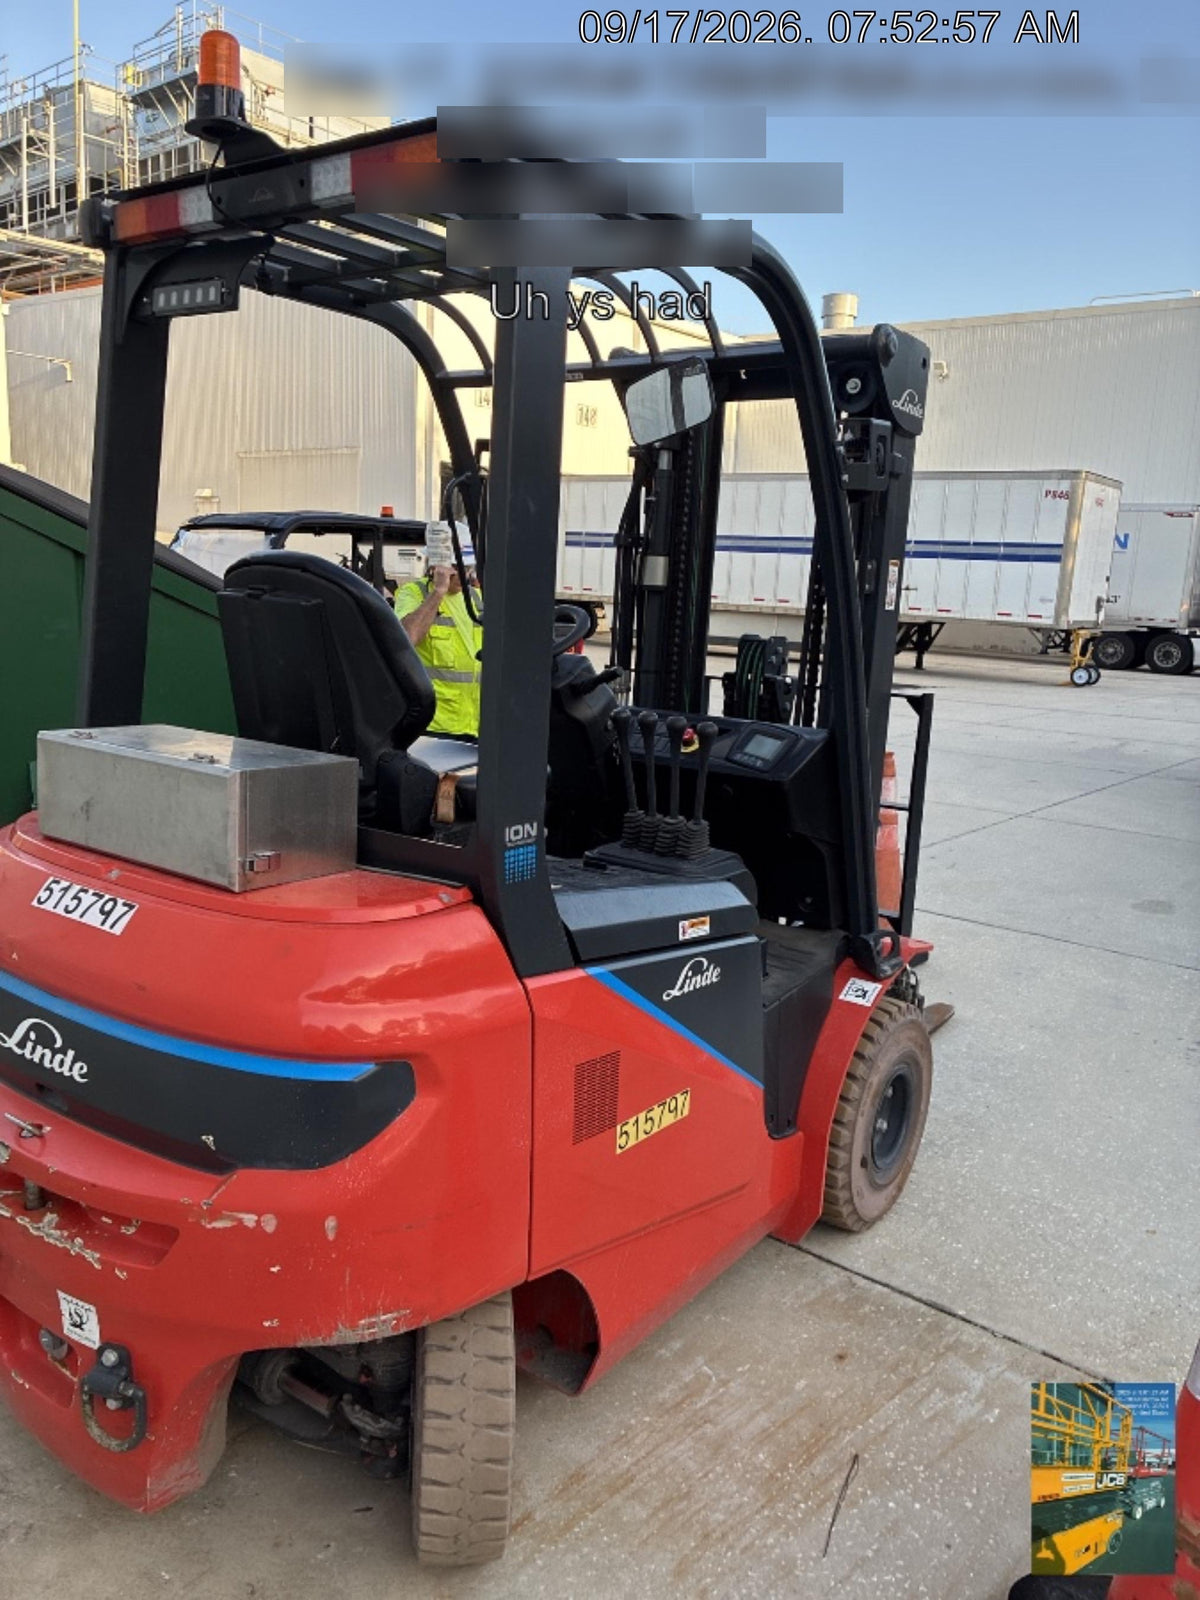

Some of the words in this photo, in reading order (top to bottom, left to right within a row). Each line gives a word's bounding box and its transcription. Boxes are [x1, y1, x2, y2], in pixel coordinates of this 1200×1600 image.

[504, 822, 538, 842] ION
[35, 879, 136, 930] 515797
[662, 957, 721, 1001] Linde
[0, 1017, 89, 1084] Linde
[618, 1089, 690, 1150] 515797
